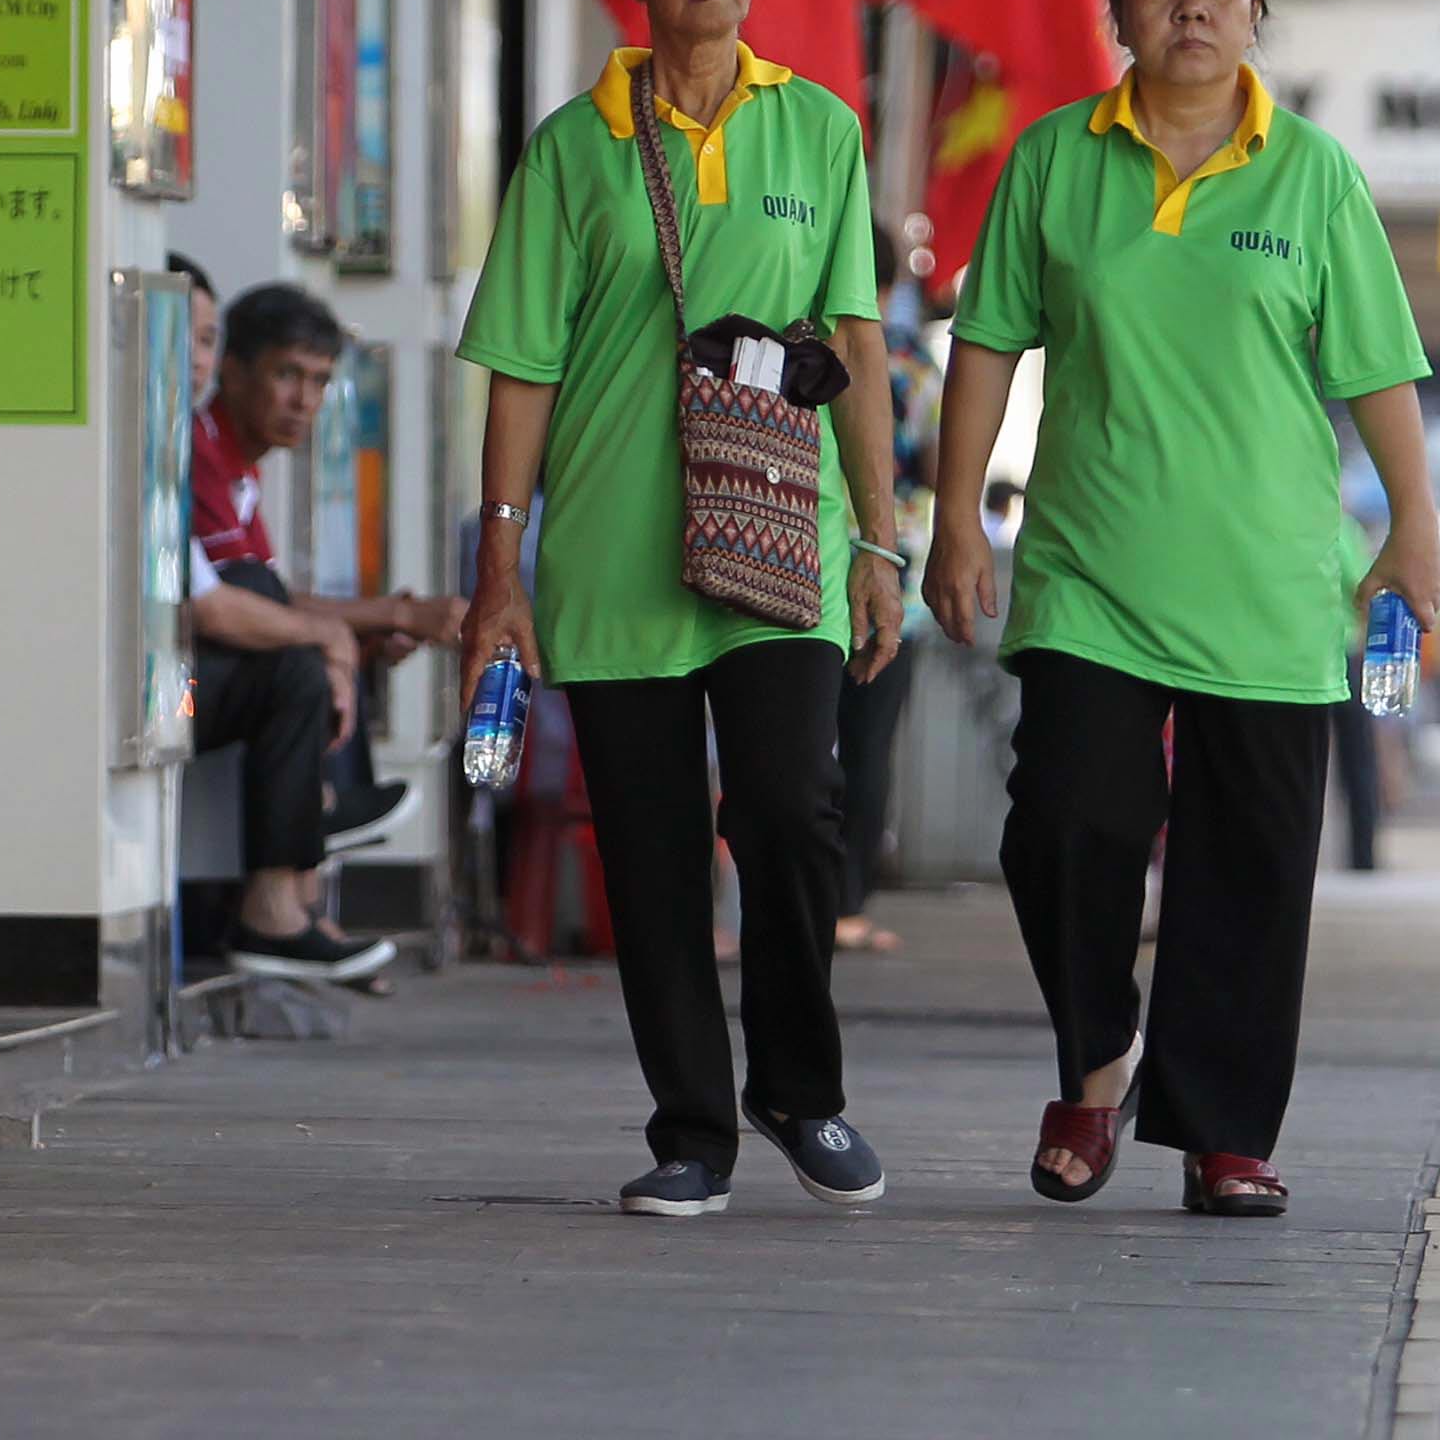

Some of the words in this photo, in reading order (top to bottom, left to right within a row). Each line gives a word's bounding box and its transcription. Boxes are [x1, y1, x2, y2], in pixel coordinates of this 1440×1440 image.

[763, 192, 807, 226] QUẬN
[809, 206, 816, 229] 1
[1231, 228, 1290, 260] QUẬN
